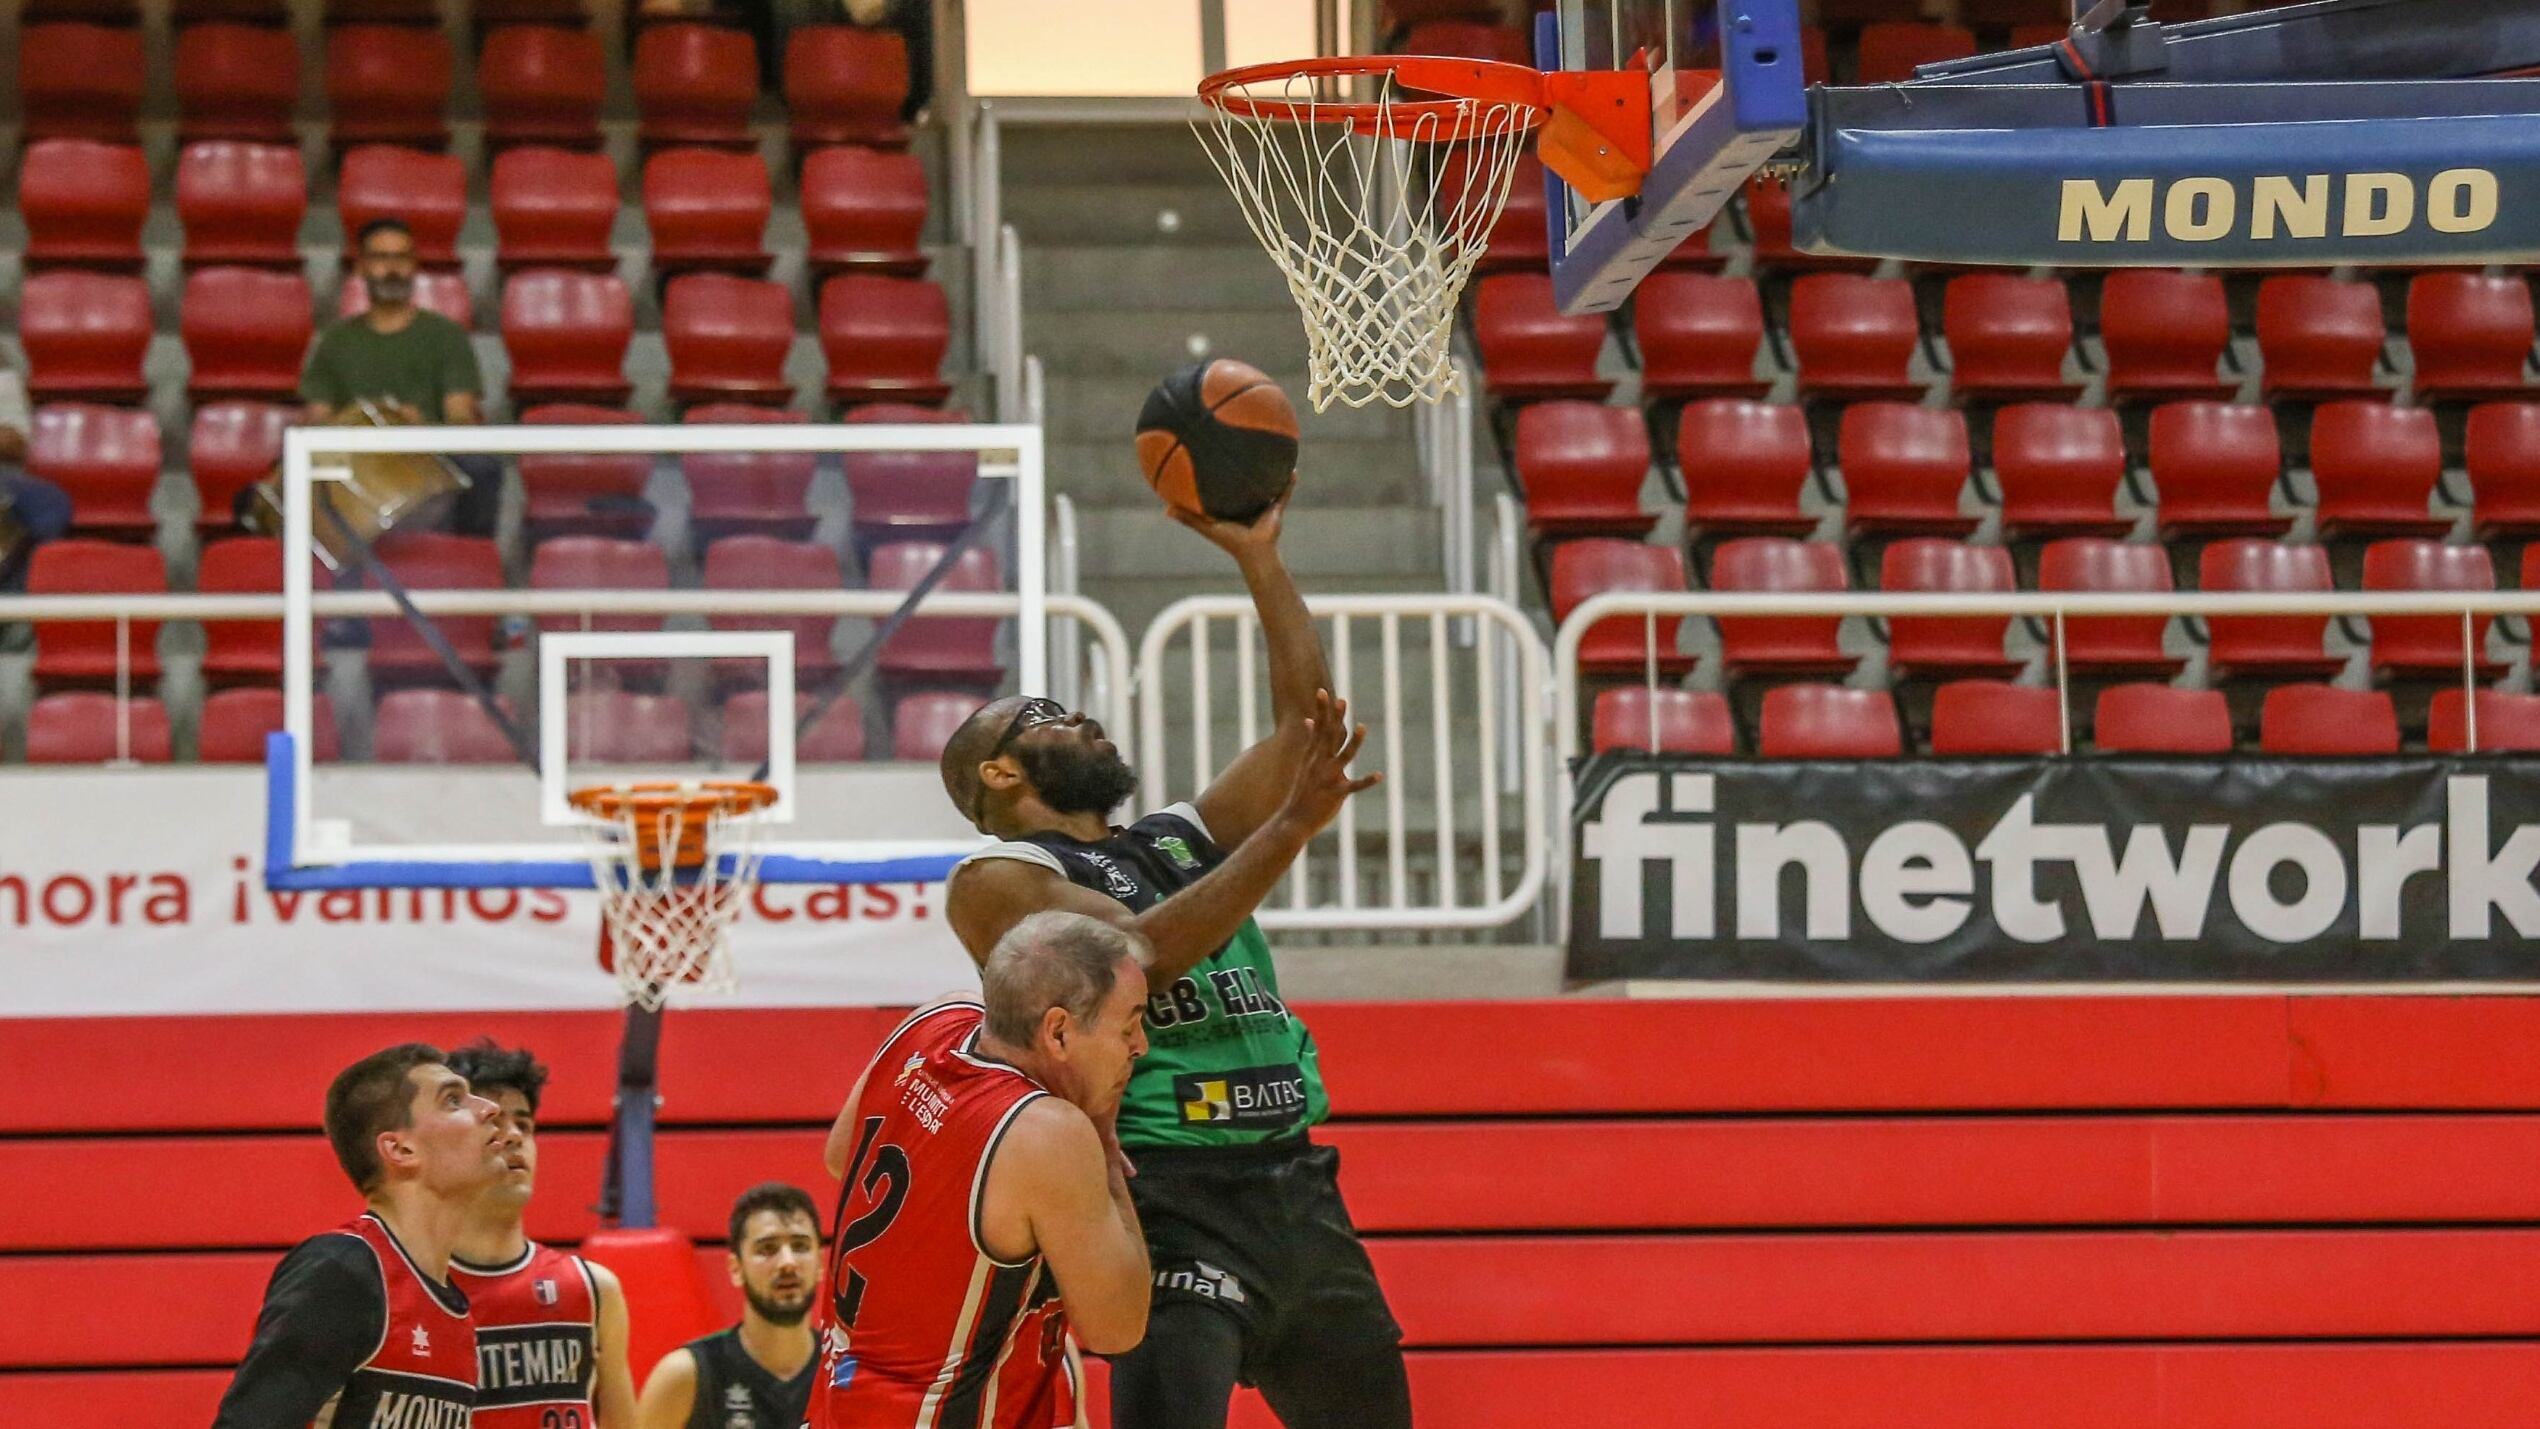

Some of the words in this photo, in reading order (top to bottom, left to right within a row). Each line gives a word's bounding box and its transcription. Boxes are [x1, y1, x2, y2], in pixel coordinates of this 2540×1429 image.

[2057, 168, 2498, 242] MONDO
[1583, 773, 2540, 944] finetwork
[1146, 976, 1210, 1030] CB
[829, 1115, 912, 1330] 12
